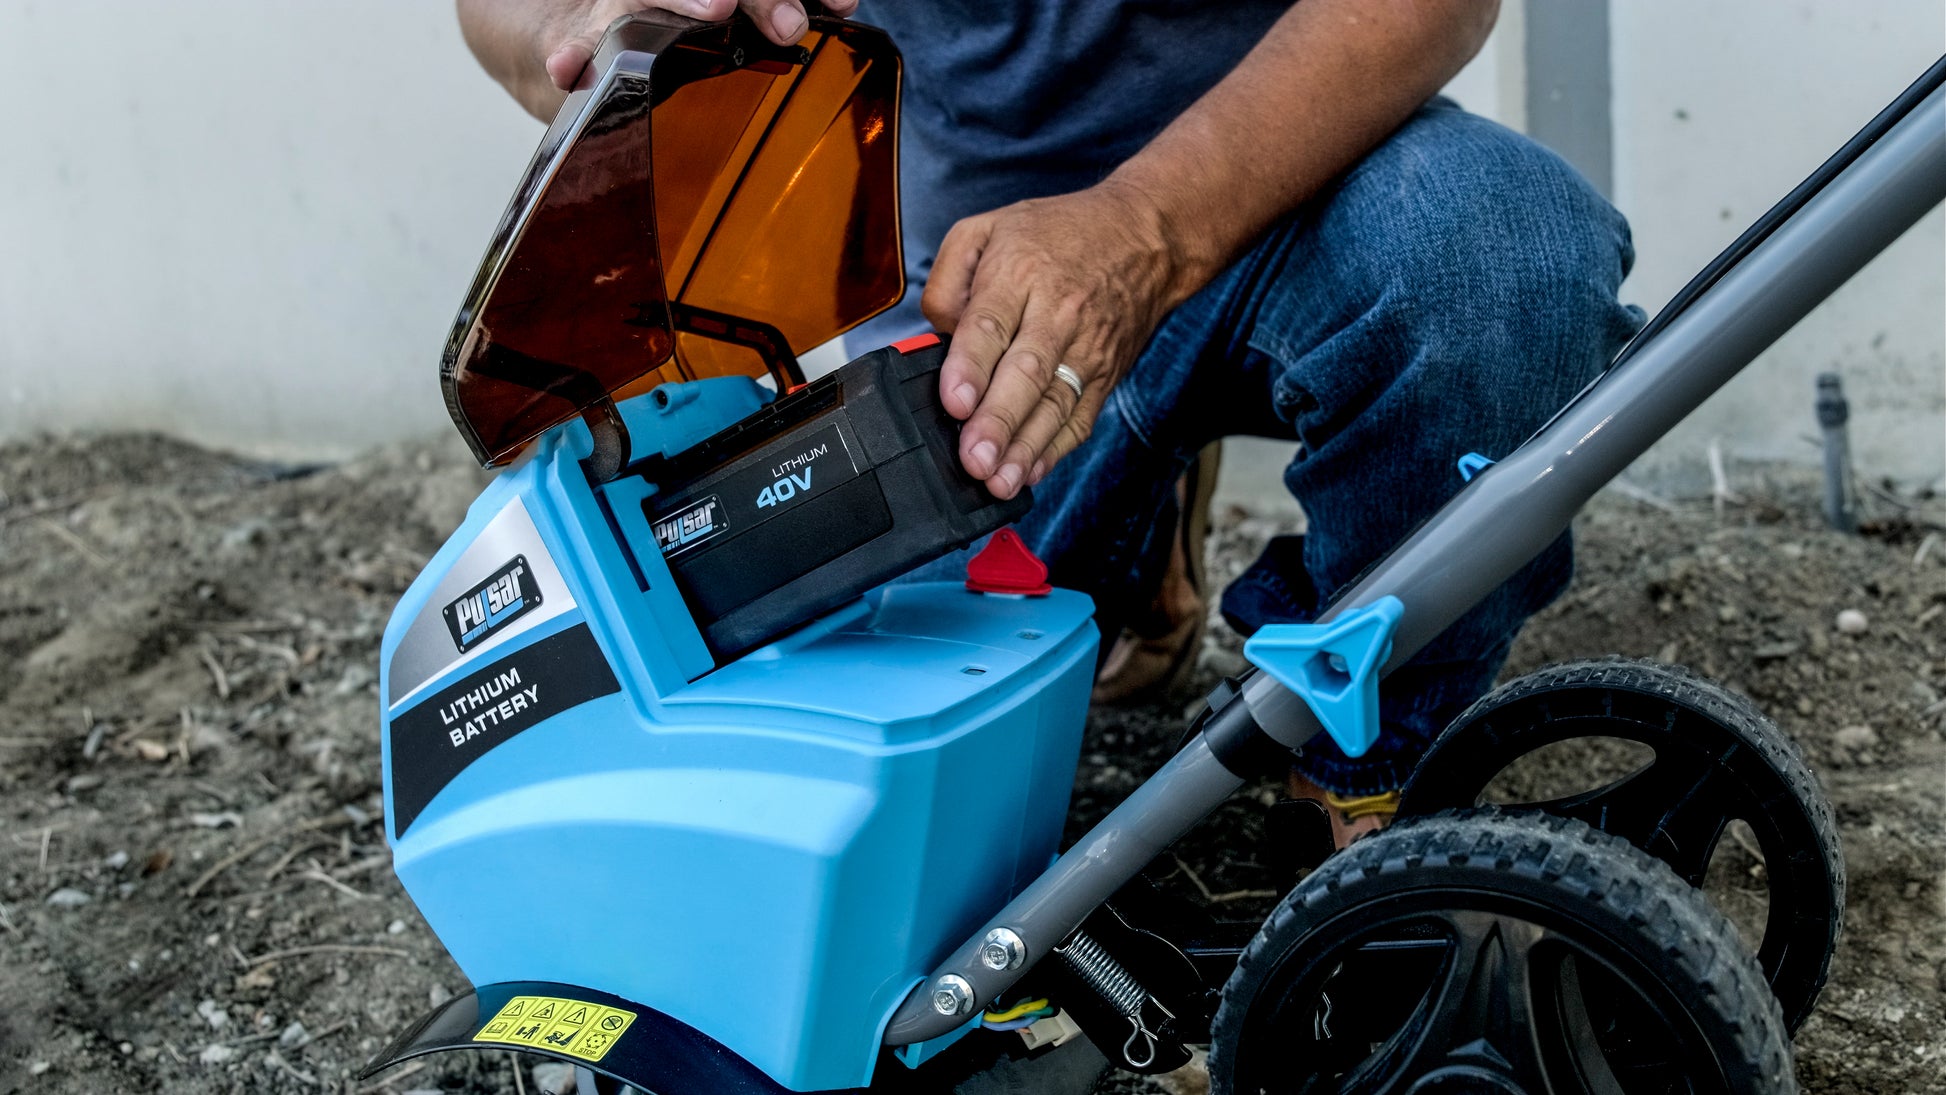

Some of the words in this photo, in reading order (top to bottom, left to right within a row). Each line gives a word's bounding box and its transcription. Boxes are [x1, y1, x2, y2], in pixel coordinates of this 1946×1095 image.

[772, 444, 828, 478] LITHIUM
[756, 466, 812, 509] 40V
[654, 502, 716, 547] Pulsar
[455, 565, 524, 635] Pulsar
[440, 667, 521, 725] LITHIUM
[449, 684, 539, 748] BATTERY
[578, 1047, 597, 1056] STOP
